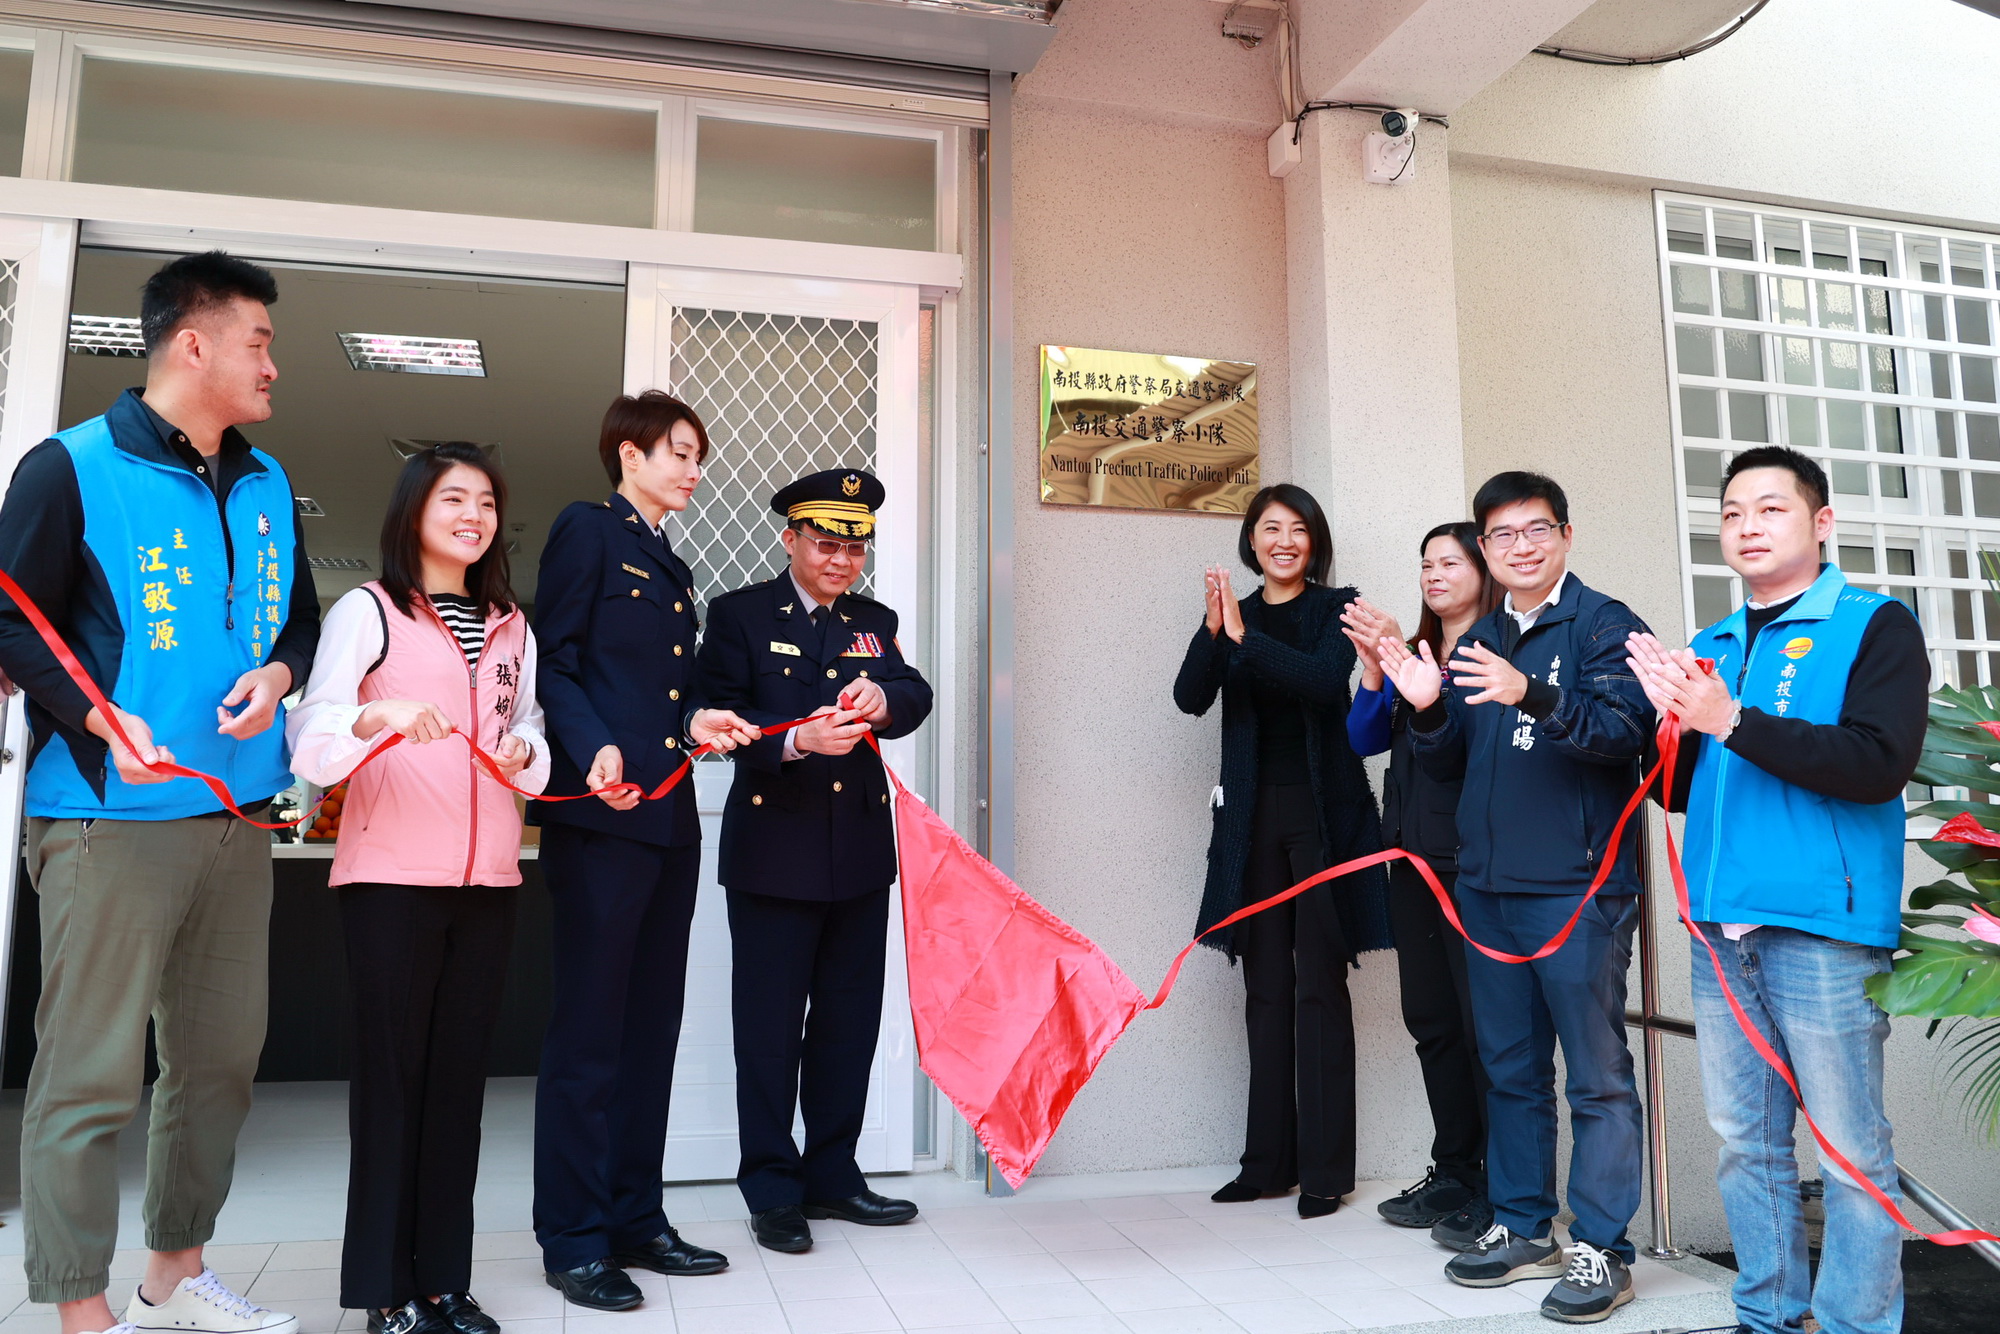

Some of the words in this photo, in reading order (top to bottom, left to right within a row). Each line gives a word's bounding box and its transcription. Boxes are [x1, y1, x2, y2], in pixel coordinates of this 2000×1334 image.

[1053, 369, 1246, 402] 南投縣政府警察局交通警察隊
[1072, 411, 1228, 446] 南投交通警察小隊
[1050, 454, 1092, 475] Nantou
[1095, 458, 1143, 478] Precinct
[1145, 461, 1187, 481] Traffic
[1190, 464, 1223, 484] Police
[1226, 467, 1250, 485] Unit
[173, 527, 193, 586] 主任
[137, 545, 179, 651] 江敏源
[1774, 662, 1797, 718] 南投市
